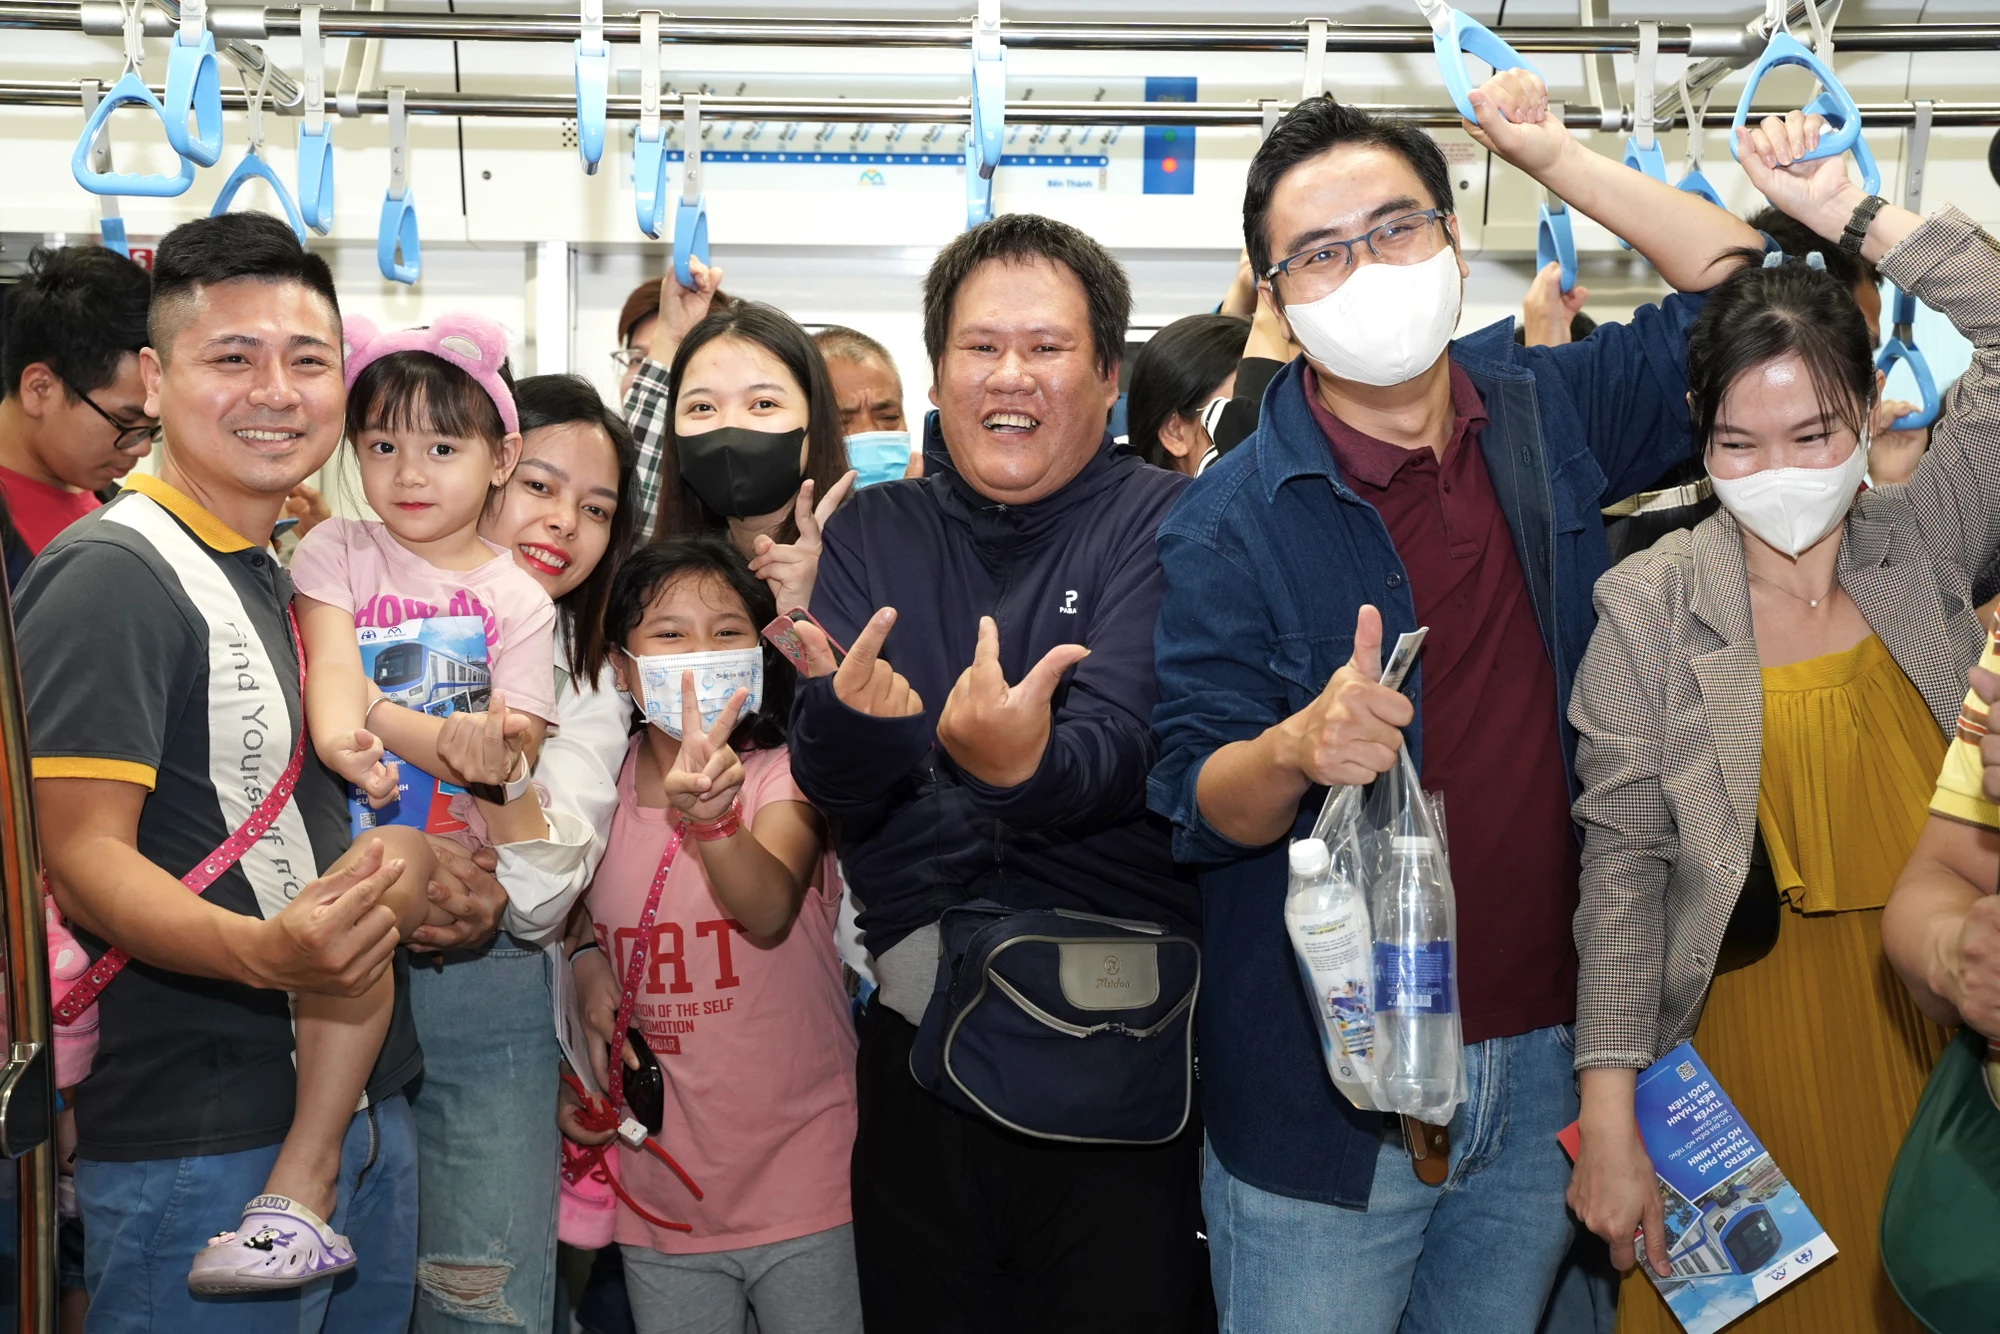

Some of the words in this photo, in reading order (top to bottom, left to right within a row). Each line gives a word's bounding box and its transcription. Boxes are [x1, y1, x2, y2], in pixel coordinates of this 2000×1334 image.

[658, 1004, 672, 1017] OF
[676, 1003, 699, 1016] THE
[703, 997, 733, 1015] SELF
[1688, 1081, 1710, 1099] SUỐI
[1696, 1090, 1716, 1106] BẾN
[1668, 1095, 1688, 1113] TIÊN
[1693, 1099, 1723, 1122] TUYẾN
[1666, 1102, 1698, 1127] THÀNH
[1691, 1119, 1712, 1136] QUANH
[1711, 1136, 1728, 1153] CHÍ
[1717, 1135, 1749, 1161] THÀNH
[1687, 1147, 1712, 1167] MINH
[1697, 1156, 1718, 1176] PHỐ
[1723, 1145, 1756, 1169] METRO
